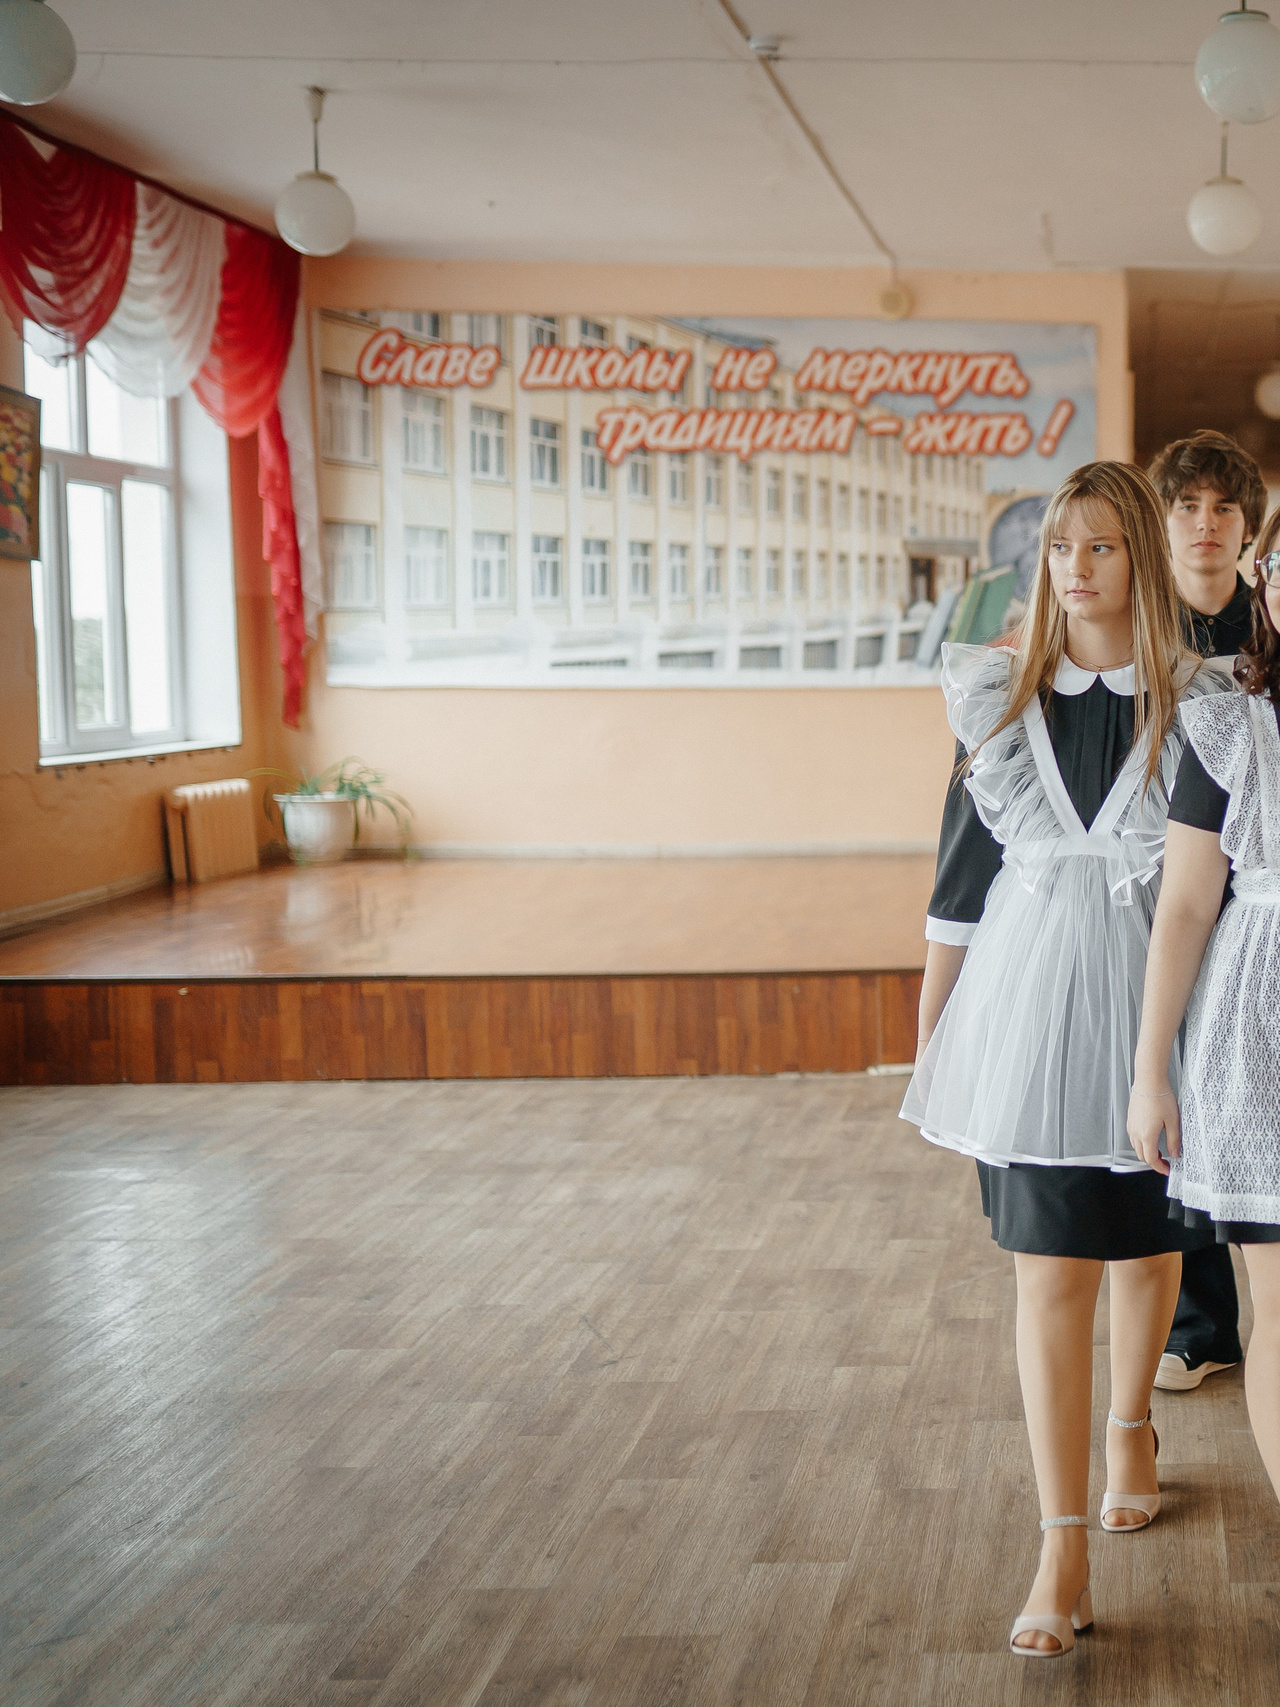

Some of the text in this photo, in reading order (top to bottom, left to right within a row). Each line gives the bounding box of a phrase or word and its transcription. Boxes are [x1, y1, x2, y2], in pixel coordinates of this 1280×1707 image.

[357, 328, 500, 388] Славе
[520, 345, 692, 391] школы
[712, 347, 777, 391] не
[597, 404, 858, 466] традициям
